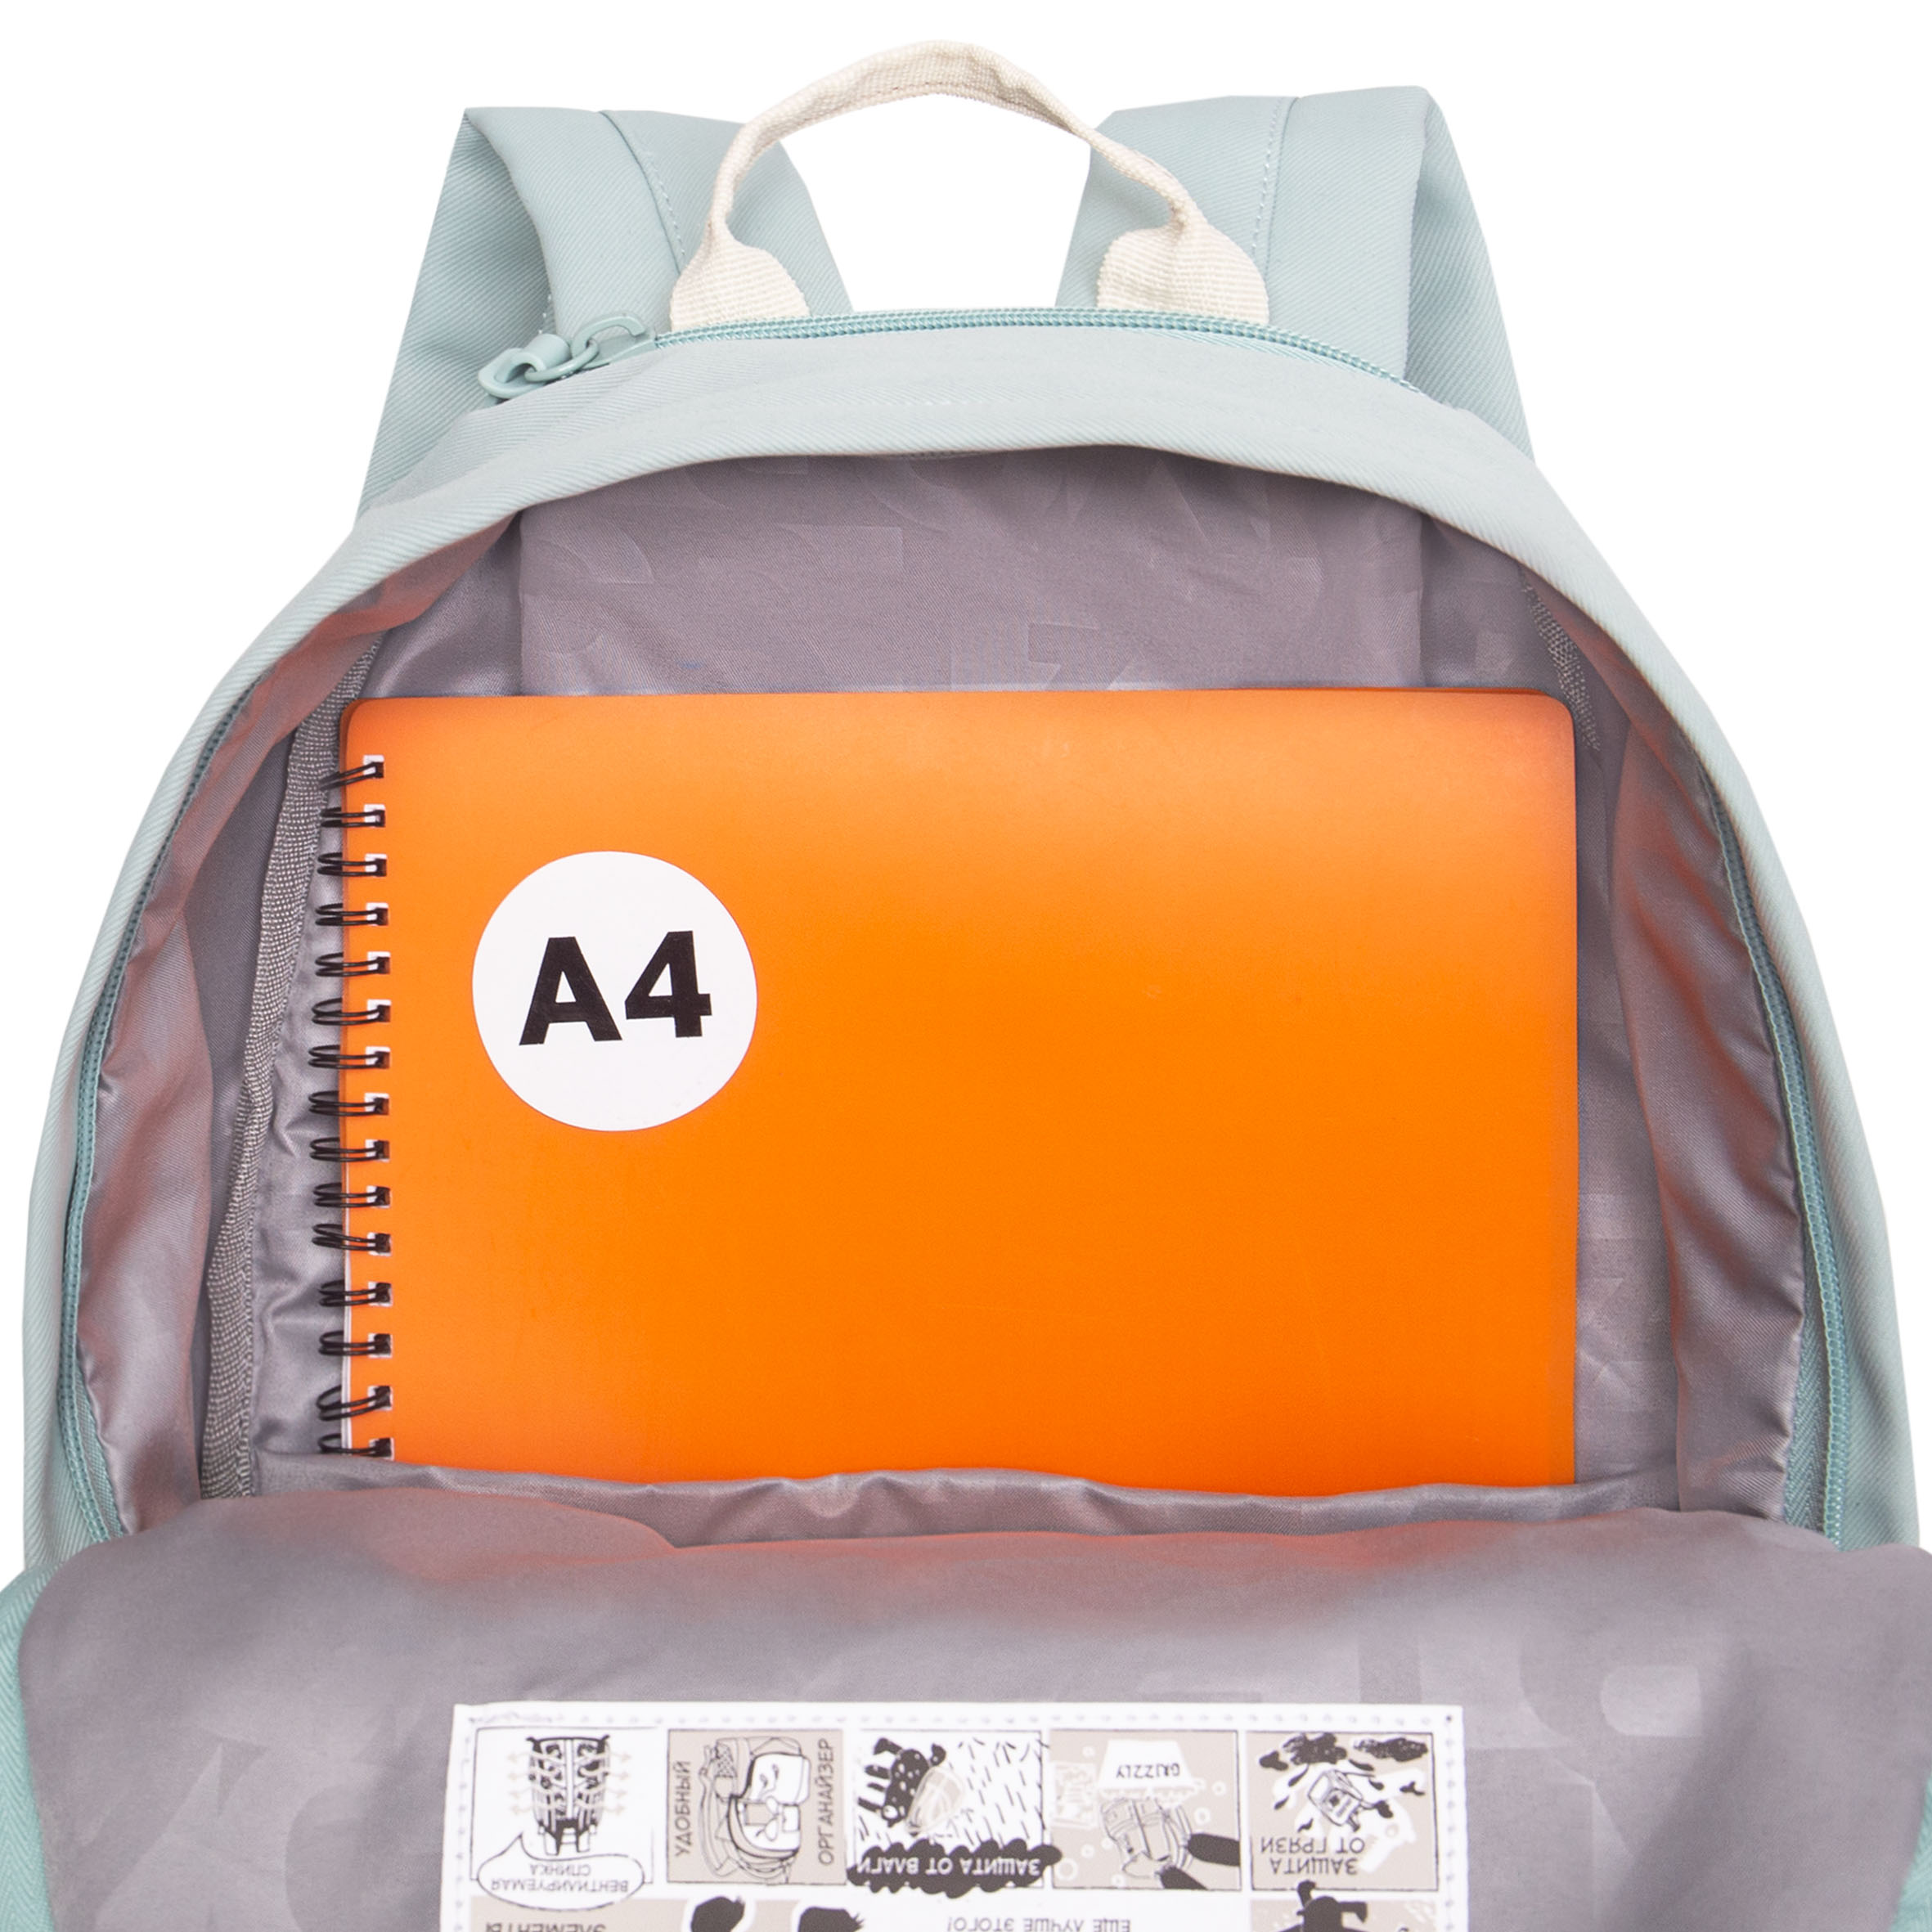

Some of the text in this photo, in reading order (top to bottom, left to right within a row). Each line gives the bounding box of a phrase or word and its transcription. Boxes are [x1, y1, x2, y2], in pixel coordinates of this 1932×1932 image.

[519, 931, 712, 1045] A4
[673, 1761, 692, 1856] УДОБНЫЙ
[815, 1738, 835, 1866] ОРГАНАЙЗЕР
[1261, 1837, 1365, 1853] ОТ ГРЯЗИ
[531, 1863, 591, 1876] СПИНКА
[856, 1856, 1041, 1876] ЗАЩИТА ОТ ВЛАГИ
[1270, 1857, 1359, 1875] ЗАЩИТА
[491, 1880, 628, 1894] ВЕНТИЛИРУЕМАЯ
[947, 1917, 1014, 1932] ЭТОГО!
[1024, 1918, 1085, 1932] ЛУЧШЕ
